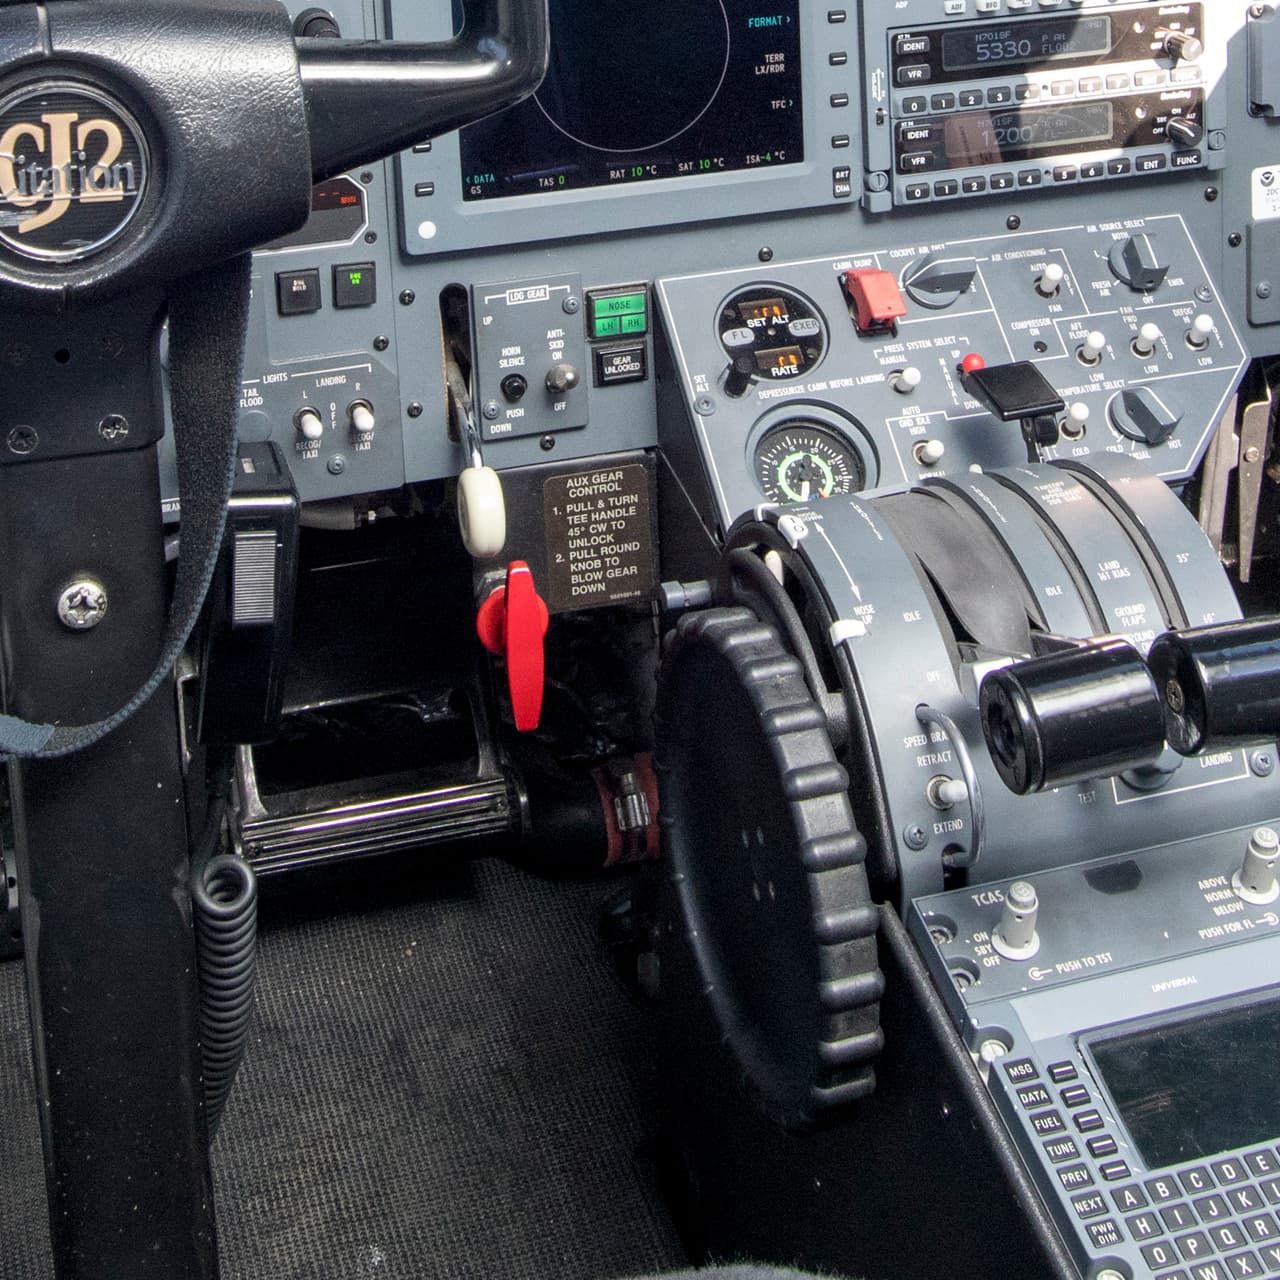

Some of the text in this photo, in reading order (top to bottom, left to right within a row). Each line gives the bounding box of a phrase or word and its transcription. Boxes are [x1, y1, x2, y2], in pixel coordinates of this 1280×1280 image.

[748, 16, 783, 28] FORMAT
[903, 42, 924, 51] IDENT
[976, 40, 1031, 60] 5330
[1177, 155, 1197, 165] FUNC
[510, 288, 545, 300] LDG GEAR
[608, 300, 631, 310] NOSE
[747, 315, 789, 328] SET ALT
[499, 356, 525, 368] SILENCE
[605, 361, 640, 373] UNLOCKED
[612, 356, 632, 365] GEAR
[263, 373, 288, 384] LIGHTS
[772, 365, 799, 377] RATE
[316, 375, 346, 387] LANDING
[567, 471, 623, 488] AUX GEAR
[569, 482, 622, 498] CONTROL
[553, 494, 638, 515] 1. PULL & TURN
[568, 506, 637, 525] TEE HANDLE
[568, 520, 625, 537] 45° CW TO
[569, 533, 614, 549] UNLOCK
[556, 541, 640, 563] 2. PULL ROUND
[571, 557, 619, 572] KNOB TO
[571, 566, 638, 585] BLOW GEAR
[572, 583, 606, 596] DOWN
[916, 750, 952, 768] RETRACT
[933, 818, 964, 834] EXTEND
[1198, 875, 1228, 891] ABOVE
[971, 890, 1004, 907] TCAS
[1008, 1063, 1033, 1079] MSG
[1020, 1089, 1048, 1105] DATA
[1047, 1142, 1076, 1156] TUNE
[1075, 1197, 1103, 1212] NEXT
